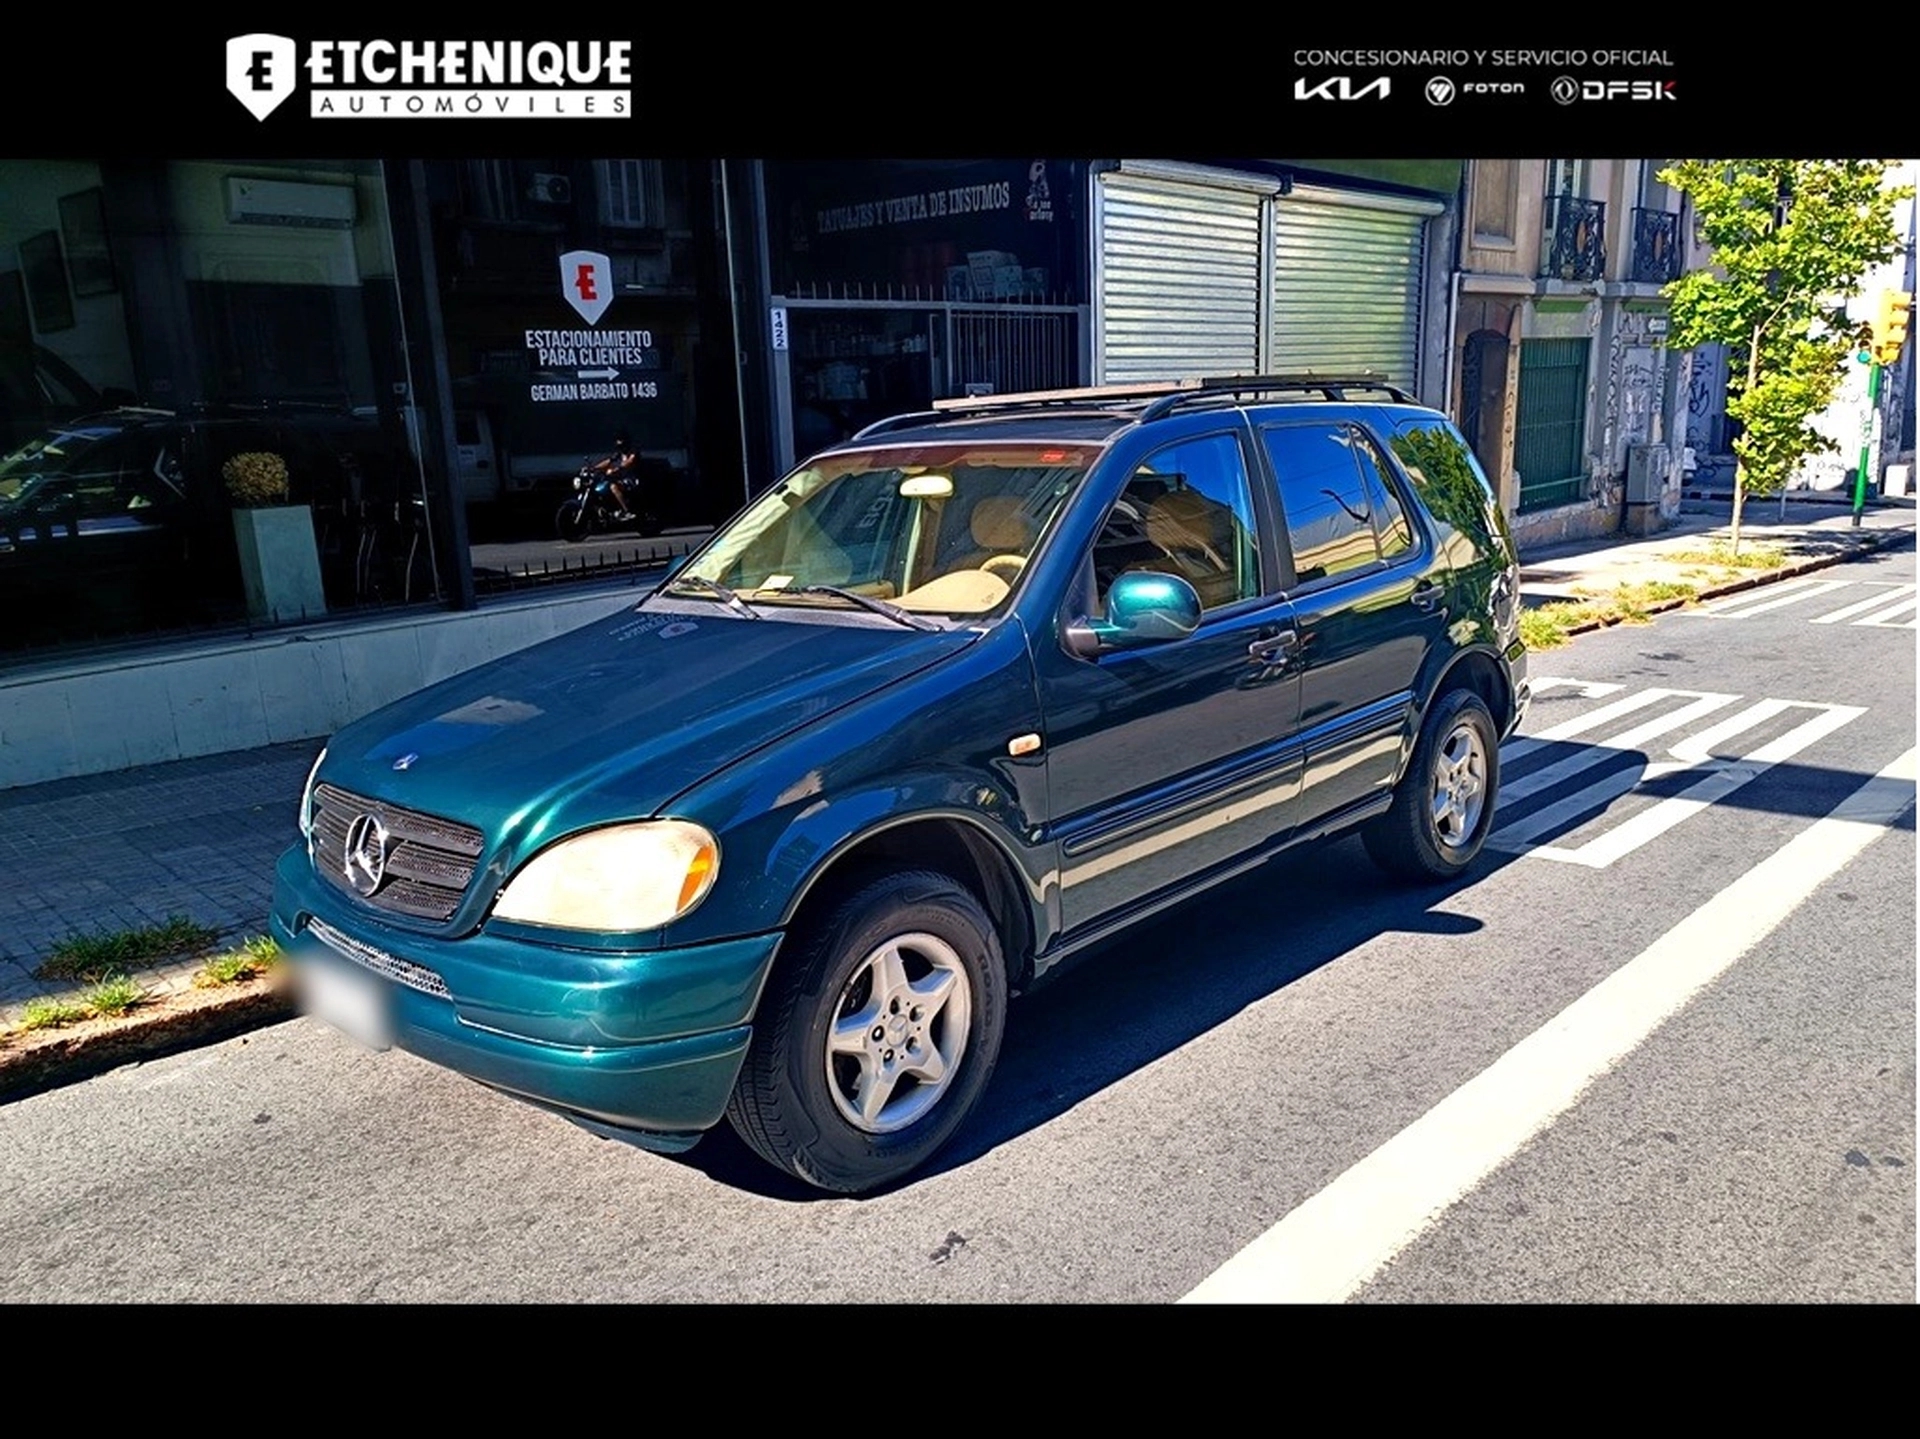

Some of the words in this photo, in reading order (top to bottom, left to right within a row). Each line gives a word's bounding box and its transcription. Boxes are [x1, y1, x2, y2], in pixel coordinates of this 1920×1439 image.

[817, 203, 873, 234] TATUAJES
[872, 201, 884, 225] Y
[885, 194, 927, 223] VENTA
[929, 190, 947, 217] DE
[949, 181, 1010, 215] INSUMOS
[525, 330, 652, 349] ESTACIONAMIENTO
[774, 310, 785, 348] 1422
[538, 348, 577, 366] PARA
[579, 348, 643, 366] CLIENTES
[530, 384, 578, 402] GERMAN
[580, 383, 629, 400] BARBATO
[631, 381, 658, 398] 1436
